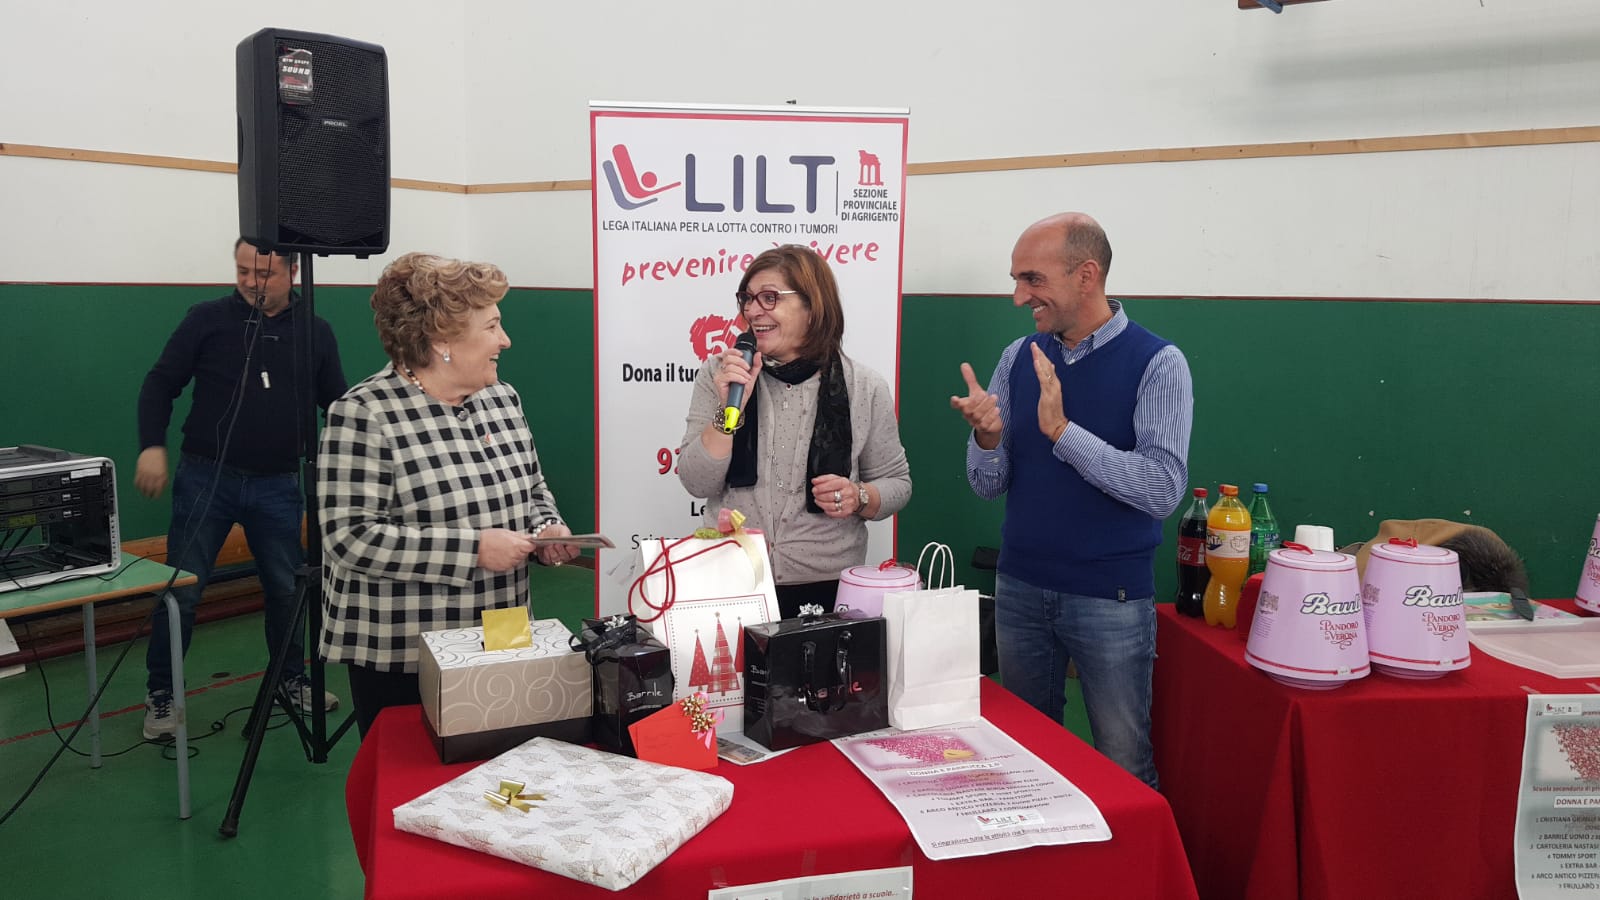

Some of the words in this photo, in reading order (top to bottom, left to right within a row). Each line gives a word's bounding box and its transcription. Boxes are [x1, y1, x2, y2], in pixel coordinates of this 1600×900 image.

[282, 65, 310, 75] SOUND
[685, 153, 836, 214] LILT
[853, 189, 888, 198] SEZIONE
[843, 200, 897, 210] PROVINCIALE
[841, 212, 850, 221] DI
[851, 212, 899, 222] AGRIGENTO
[602, 220, 630, 231] LEGA
[632, 221, 677, 232] ITALIANA
[679, 221, 699, 232] PER
[701, 222, 715, 232] LA
[717, 222, 747, 233] LOTTA
[750, 223, 792, 233] CONTRO
[794, 224, 797, 233] I
[800, 224, 838, 234] TUMORI
[622, 248, 754, 286] prevenire
[810, 240, 879, 264] vere
[622, 363, 662, 382] Dona
[666, 363, 675, 382] il
[1402, 585, 1463, 607] Baul
[1300, 592, 1360, 615] Baul
[1320, 620, 1358, 630] PANDORO
[1427, 622, 1459, 631] VERONA
[1325, 631, 1357, 640] VERONA
[626, 681, 663, 701] Barrile
